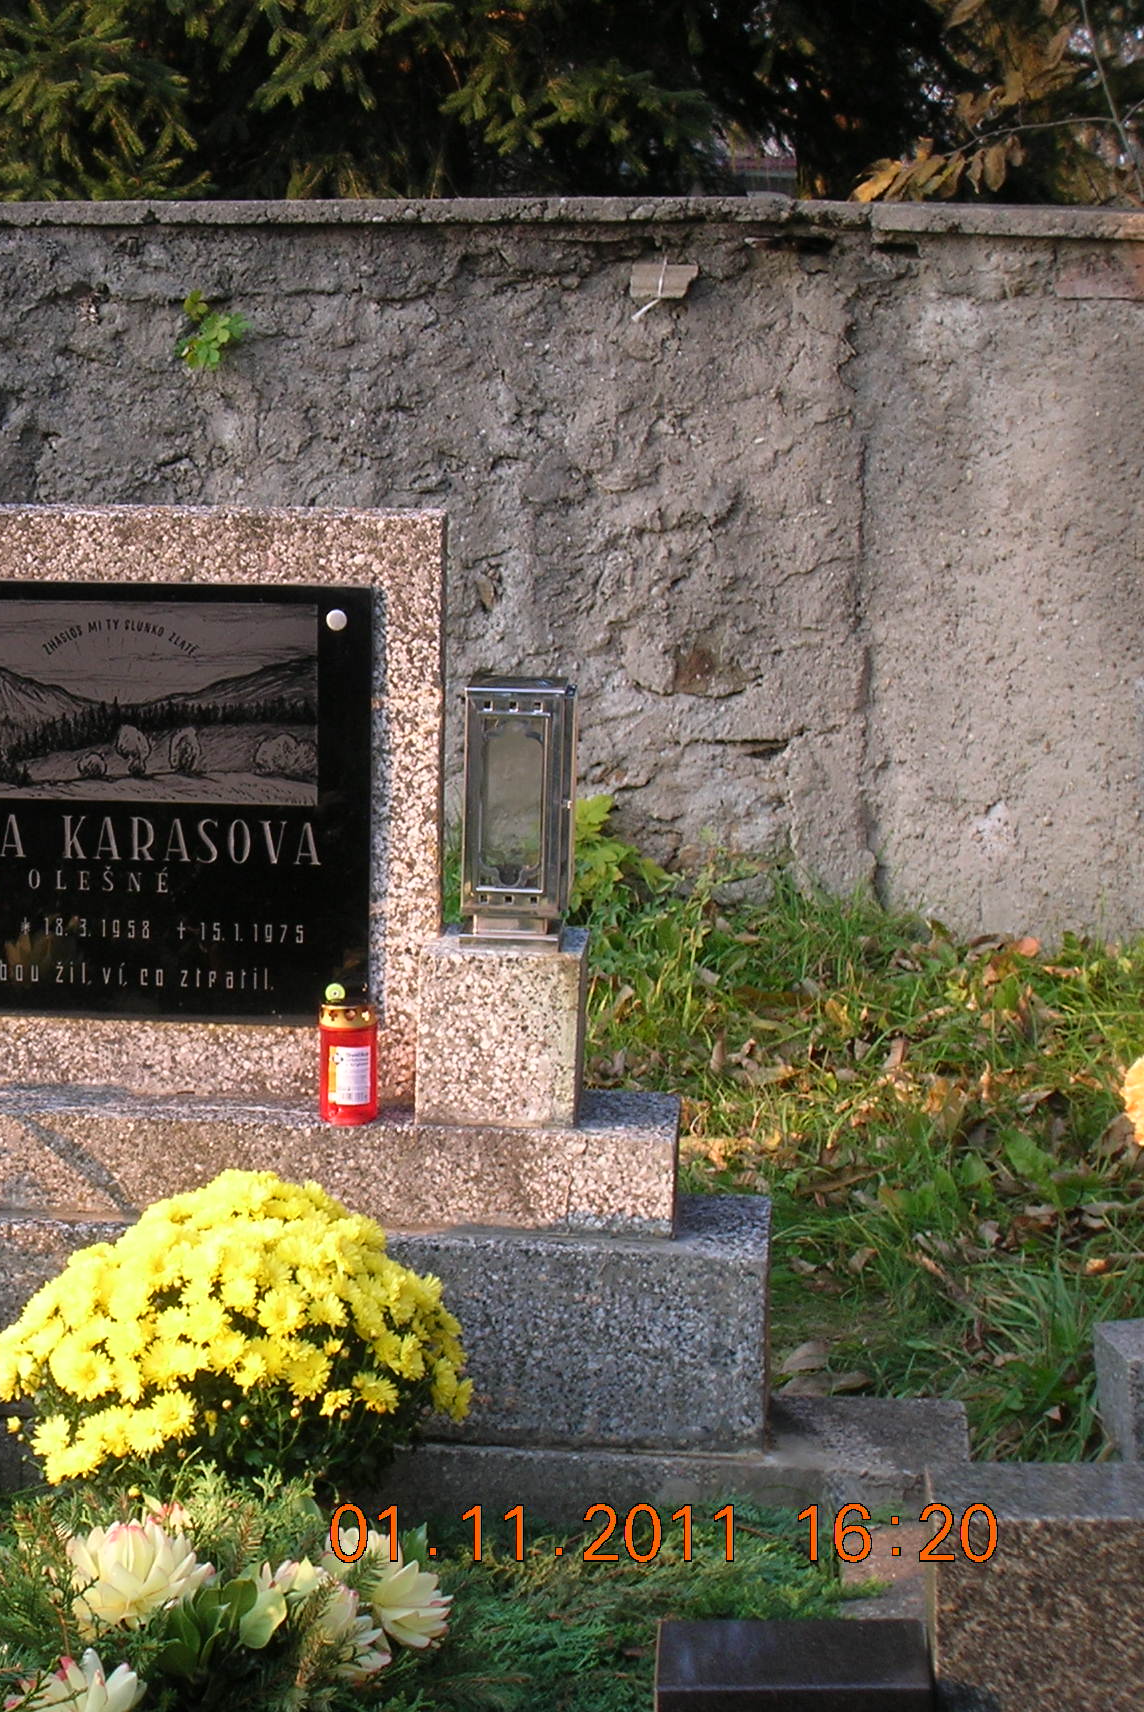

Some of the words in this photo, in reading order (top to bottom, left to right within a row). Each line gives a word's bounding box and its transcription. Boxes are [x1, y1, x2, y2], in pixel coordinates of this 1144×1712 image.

[88, 621, 102, 633] MI
[106, 619, 120, 630] TY
[62, 814, 322, 866] KARASOVA
[140, 968, 164, 986] co
